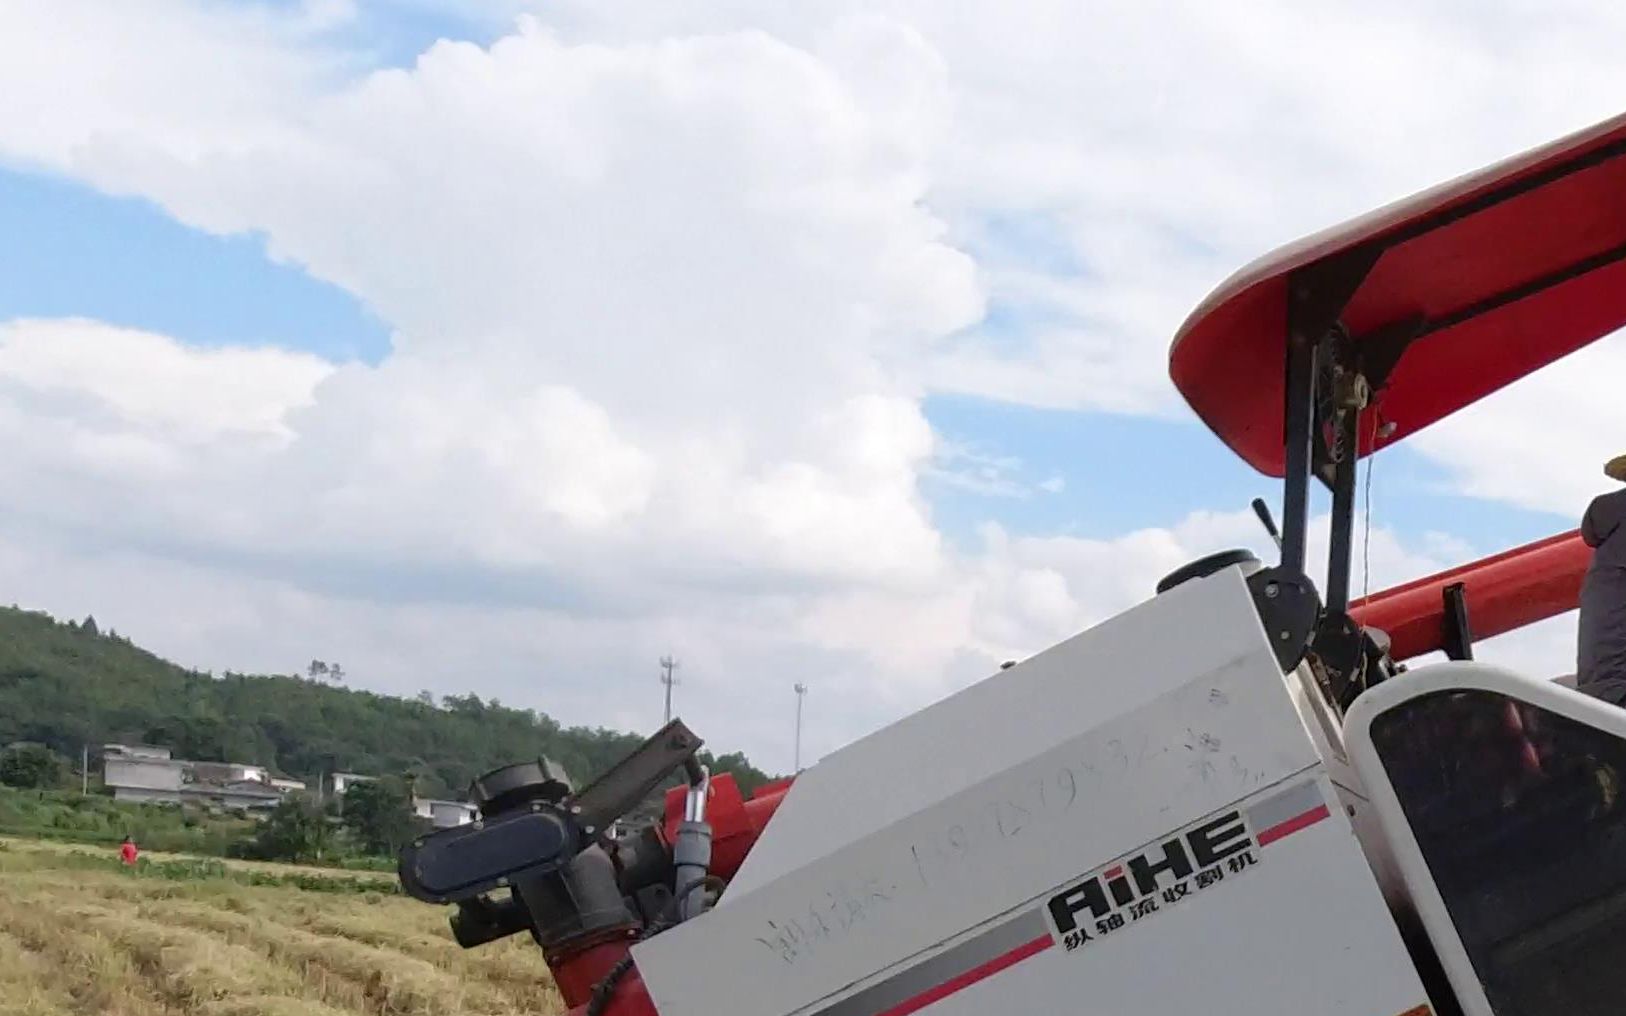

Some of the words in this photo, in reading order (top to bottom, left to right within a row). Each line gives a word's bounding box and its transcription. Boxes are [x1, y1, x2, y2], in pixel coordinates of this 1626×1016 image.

[1064, 853, 1258, 951] 纵轴流收割机
